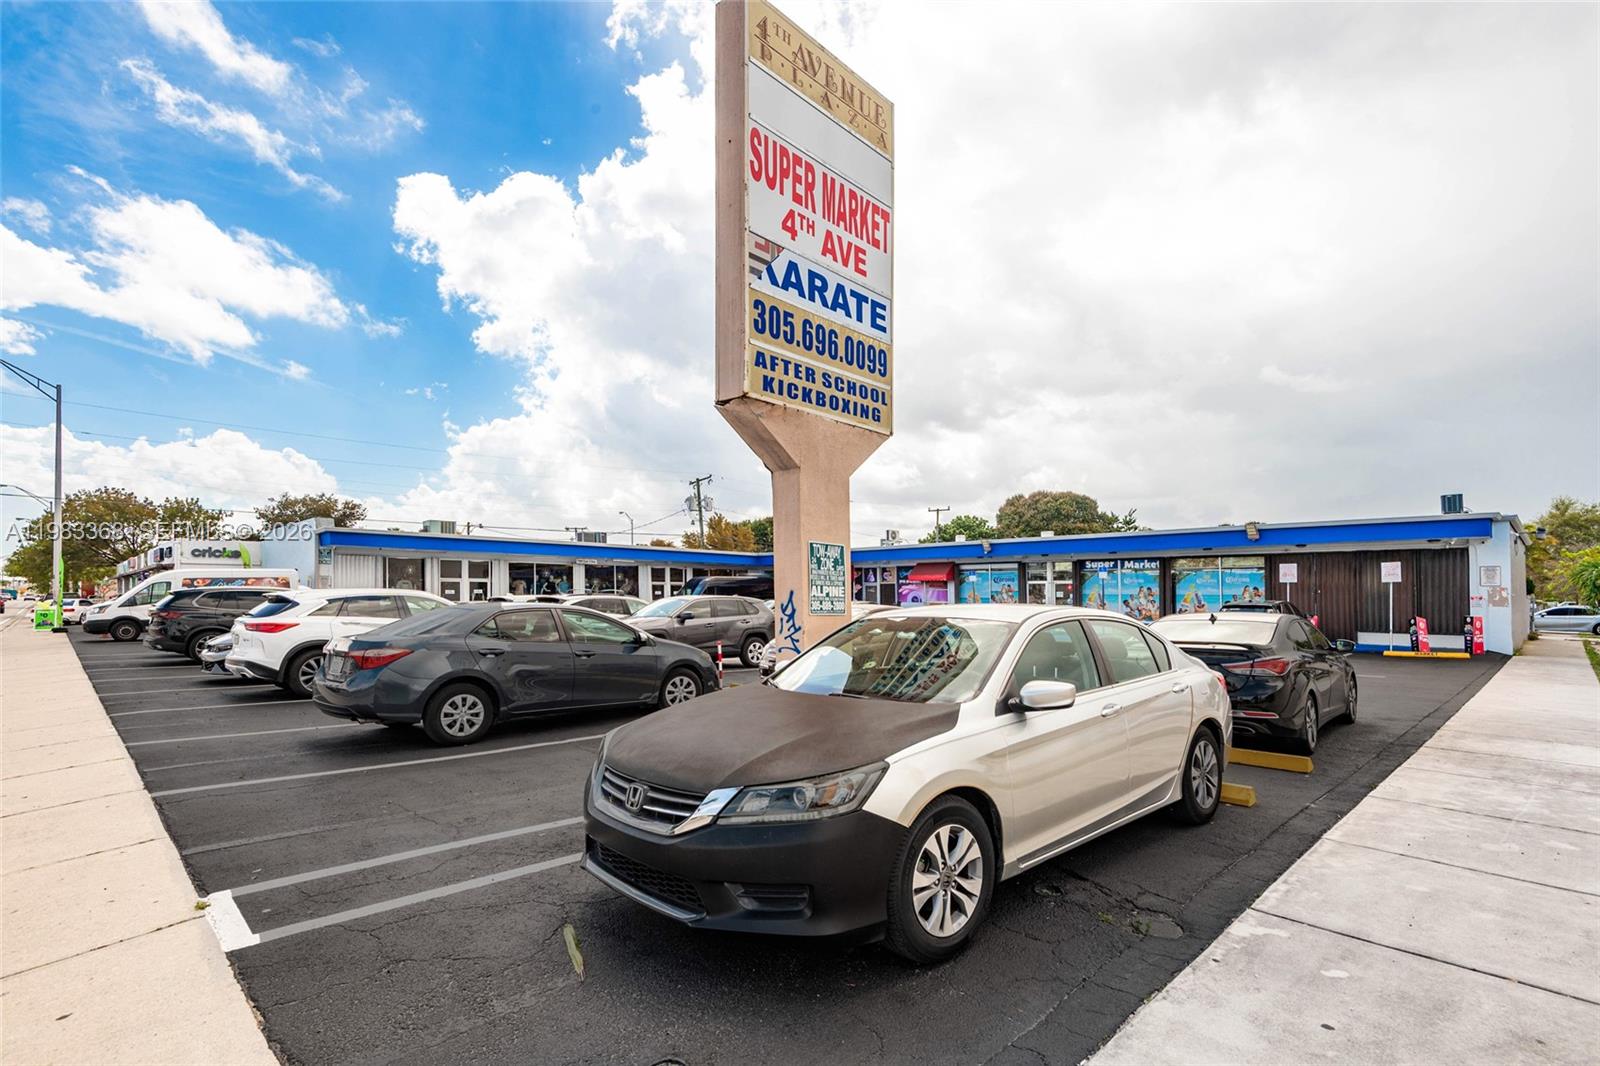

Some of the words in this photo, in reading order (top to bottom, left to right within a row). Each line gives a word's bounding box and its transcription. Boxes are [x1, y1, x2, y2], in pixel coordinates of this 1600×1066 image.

[756, 16, 791, 46] 4TH
[792, 43, 888, 131] AVENUE
[750, 127, 816, 214] SUPER
[822, 171, 890, 254] MARKET
[781, 208, 816, 241] 4TH
[821, 229, 868, 278] AVE
[753, 299, 888, 378] 305.696.0099
[754, 350, 817, 384] AFTER
[821, 371, 888, 406] SCHOOL
[762, 374, 881, 423] KICKBOXING
[190, 546, 245, 559] cricke
[820, 557, 836, 571] ZONE
[1085, 560, 1115, 568] Super
[811, 585, 845, 598] ALPINE
